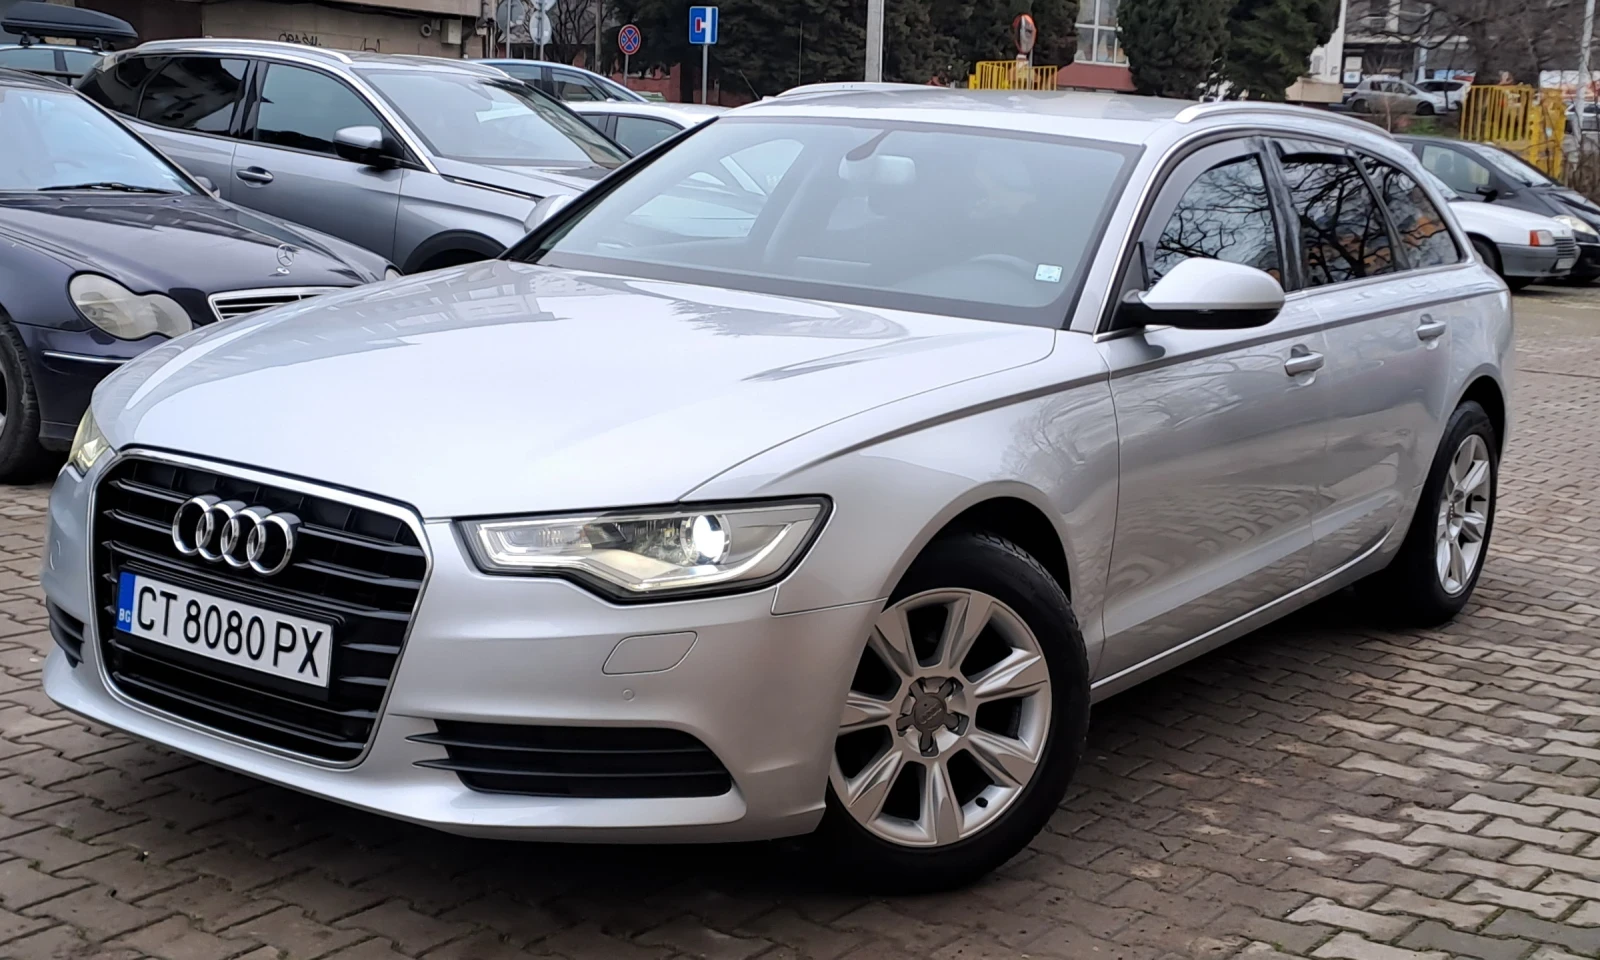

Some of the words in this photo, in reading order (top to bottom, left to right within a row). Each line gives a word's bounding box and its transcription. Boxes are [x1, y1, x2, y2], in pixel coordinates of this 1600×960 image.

[118, 608, 131, 623] BG
[137, 586, 178, 636] CT
[183, 599, 265, 661] 8080
[273, 621, 323, 677] PX
